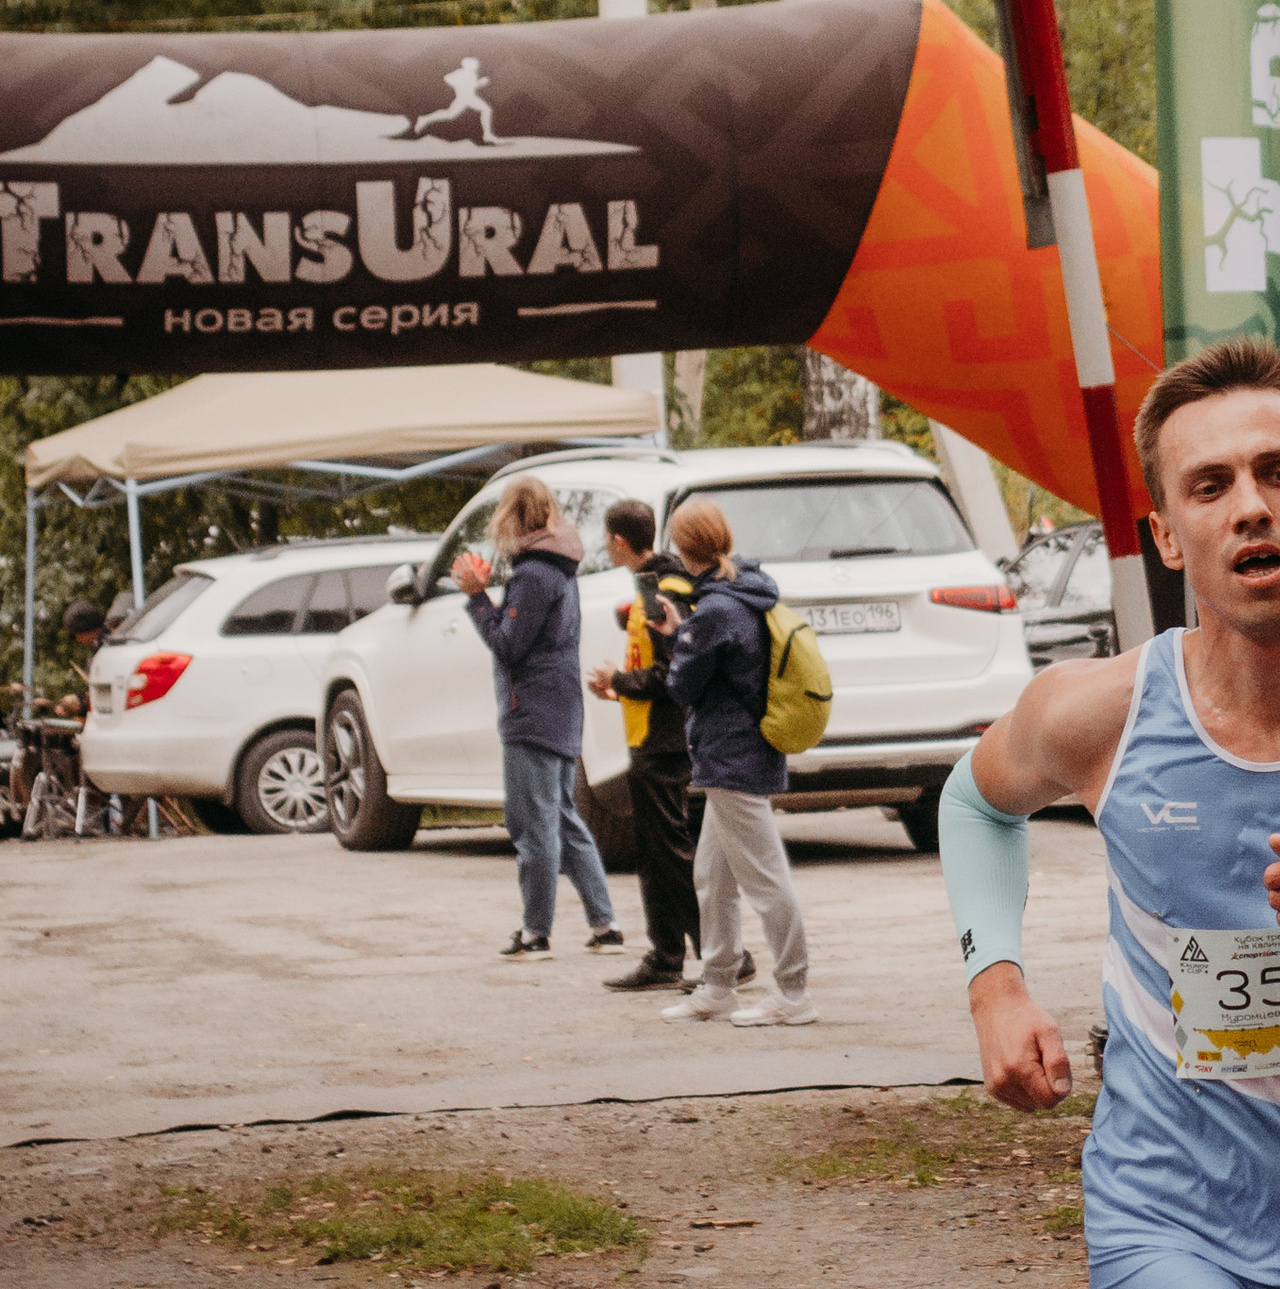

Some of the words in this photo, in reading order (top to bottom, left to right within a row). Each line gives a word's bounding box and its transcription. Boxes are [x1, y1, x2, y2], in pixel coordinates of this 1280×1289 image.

[163, 308, 314, 334] новая
[332, 302, 480, 335] серия
[1221, 1008, 1280, 1024] Муромцев
